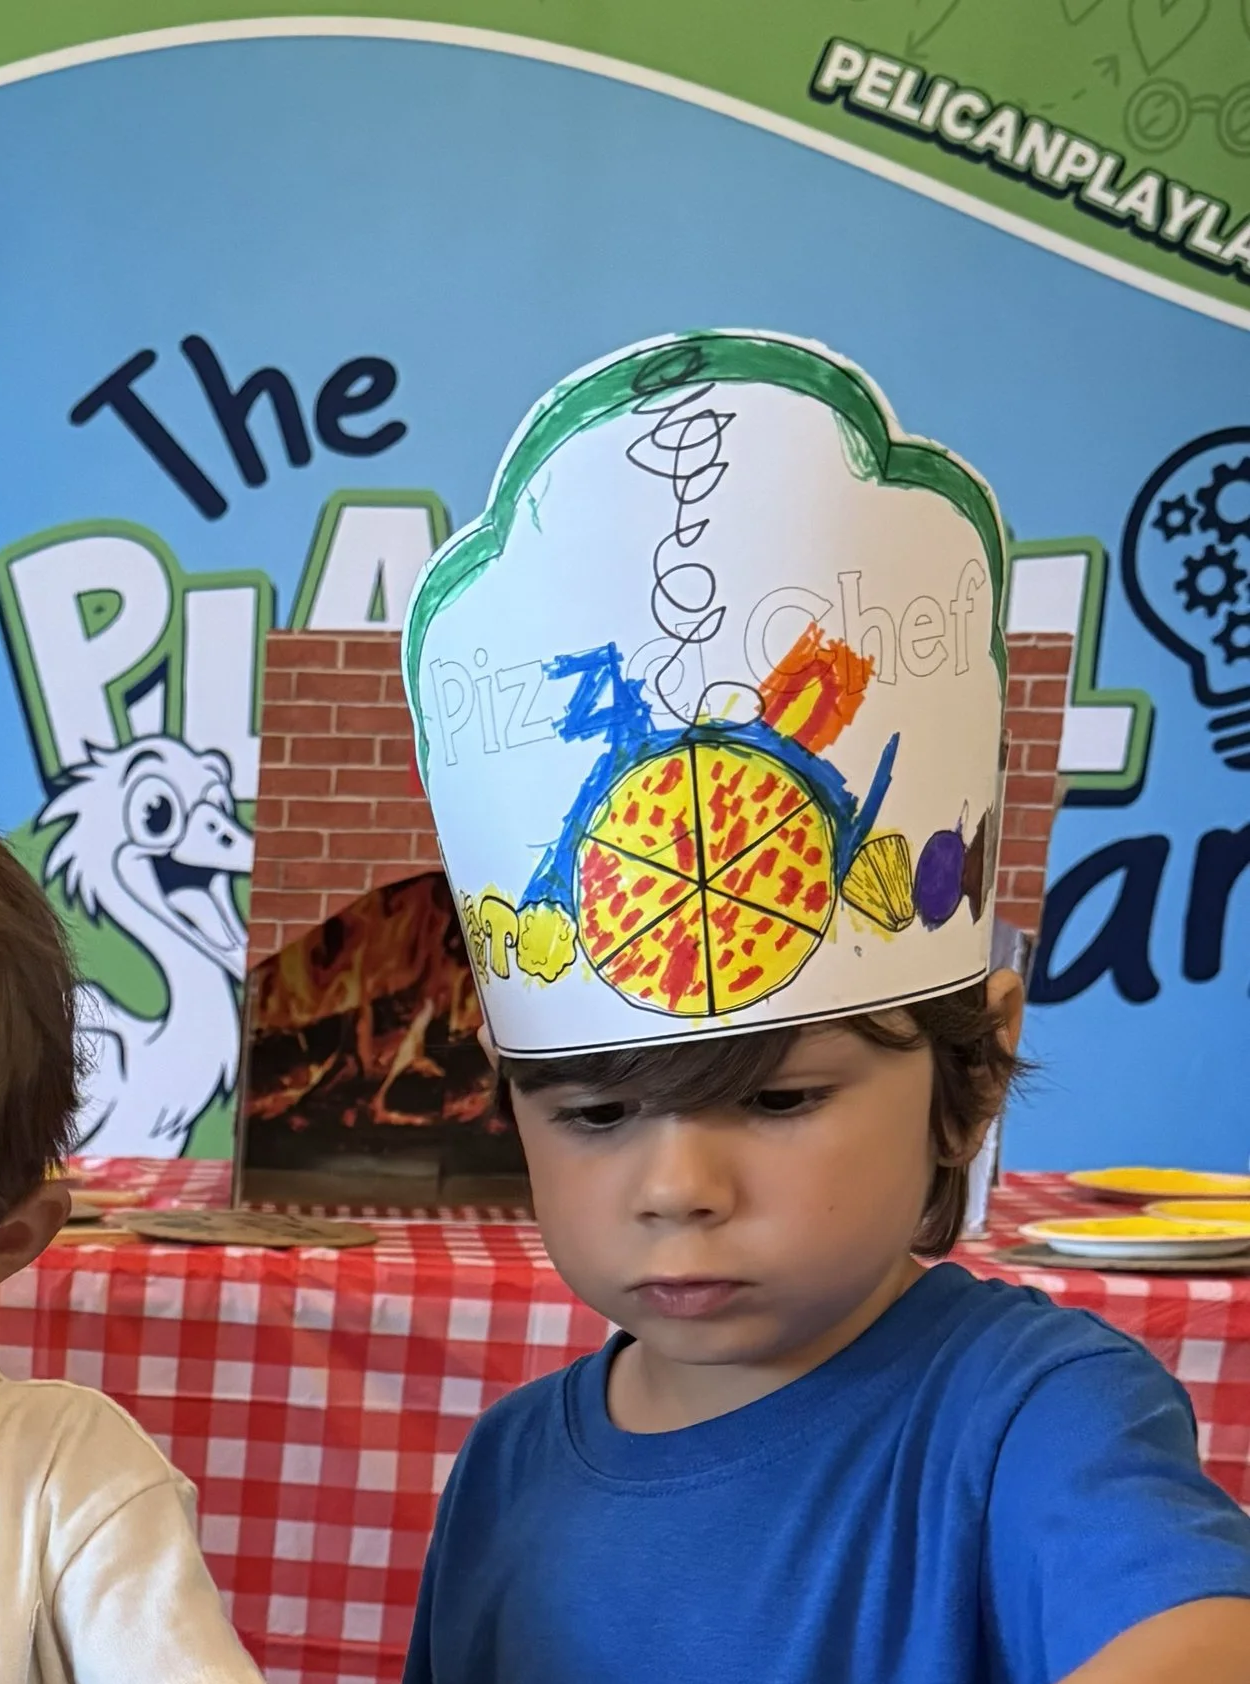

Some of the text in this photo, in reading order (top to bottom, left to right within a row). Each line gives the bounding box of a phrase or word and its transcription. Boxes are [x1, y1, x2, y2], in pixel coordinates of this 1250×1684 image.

[69, 335, 408, 521] The
[429, 559, 986, 766] Pizza Chef
